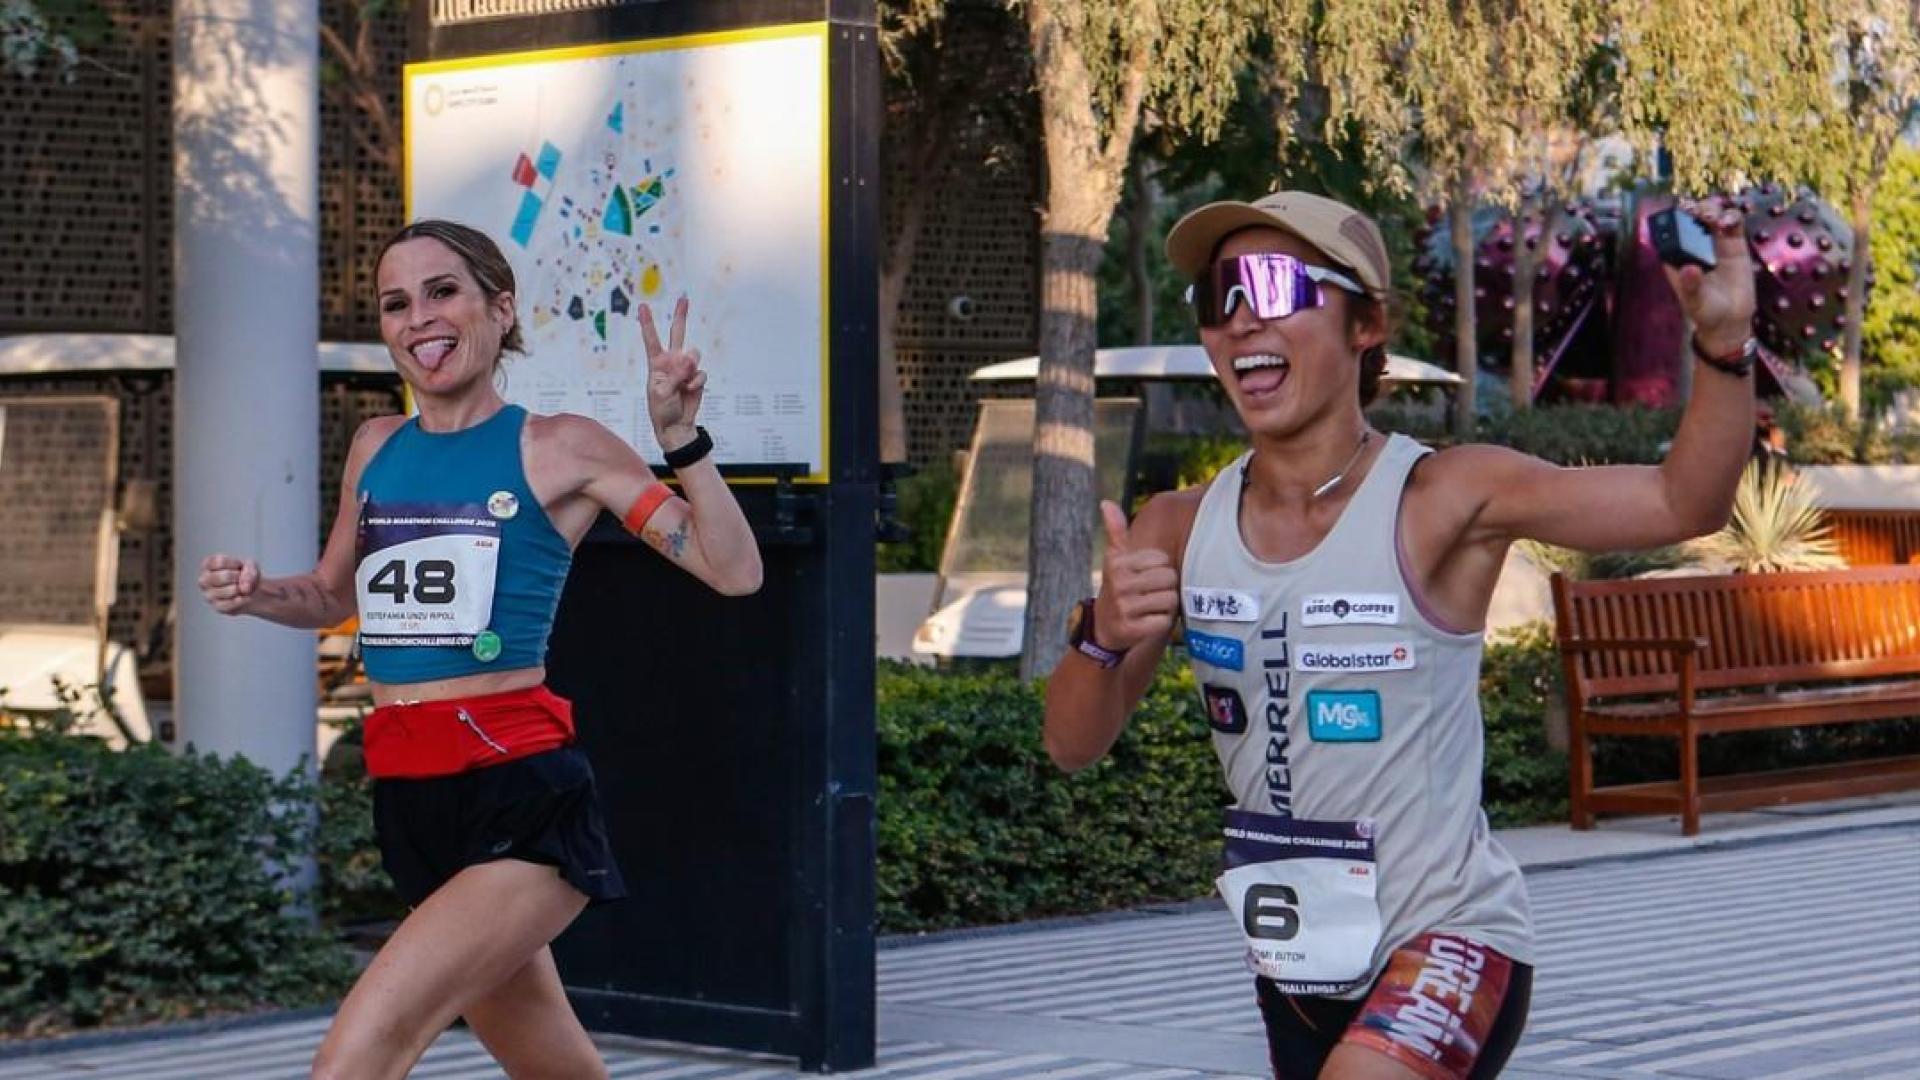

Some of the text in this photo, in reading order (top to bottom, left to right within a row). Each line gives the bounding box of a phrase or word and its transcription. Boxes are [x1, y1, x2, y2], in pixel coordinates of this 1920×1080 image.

[368, 560, 456, 604] 48
[1303, 653, 1392, 668] Globalstar
[1292, 836, 1344, 849] CHALLENGE
[1243, 883, 1299, 941] 6
